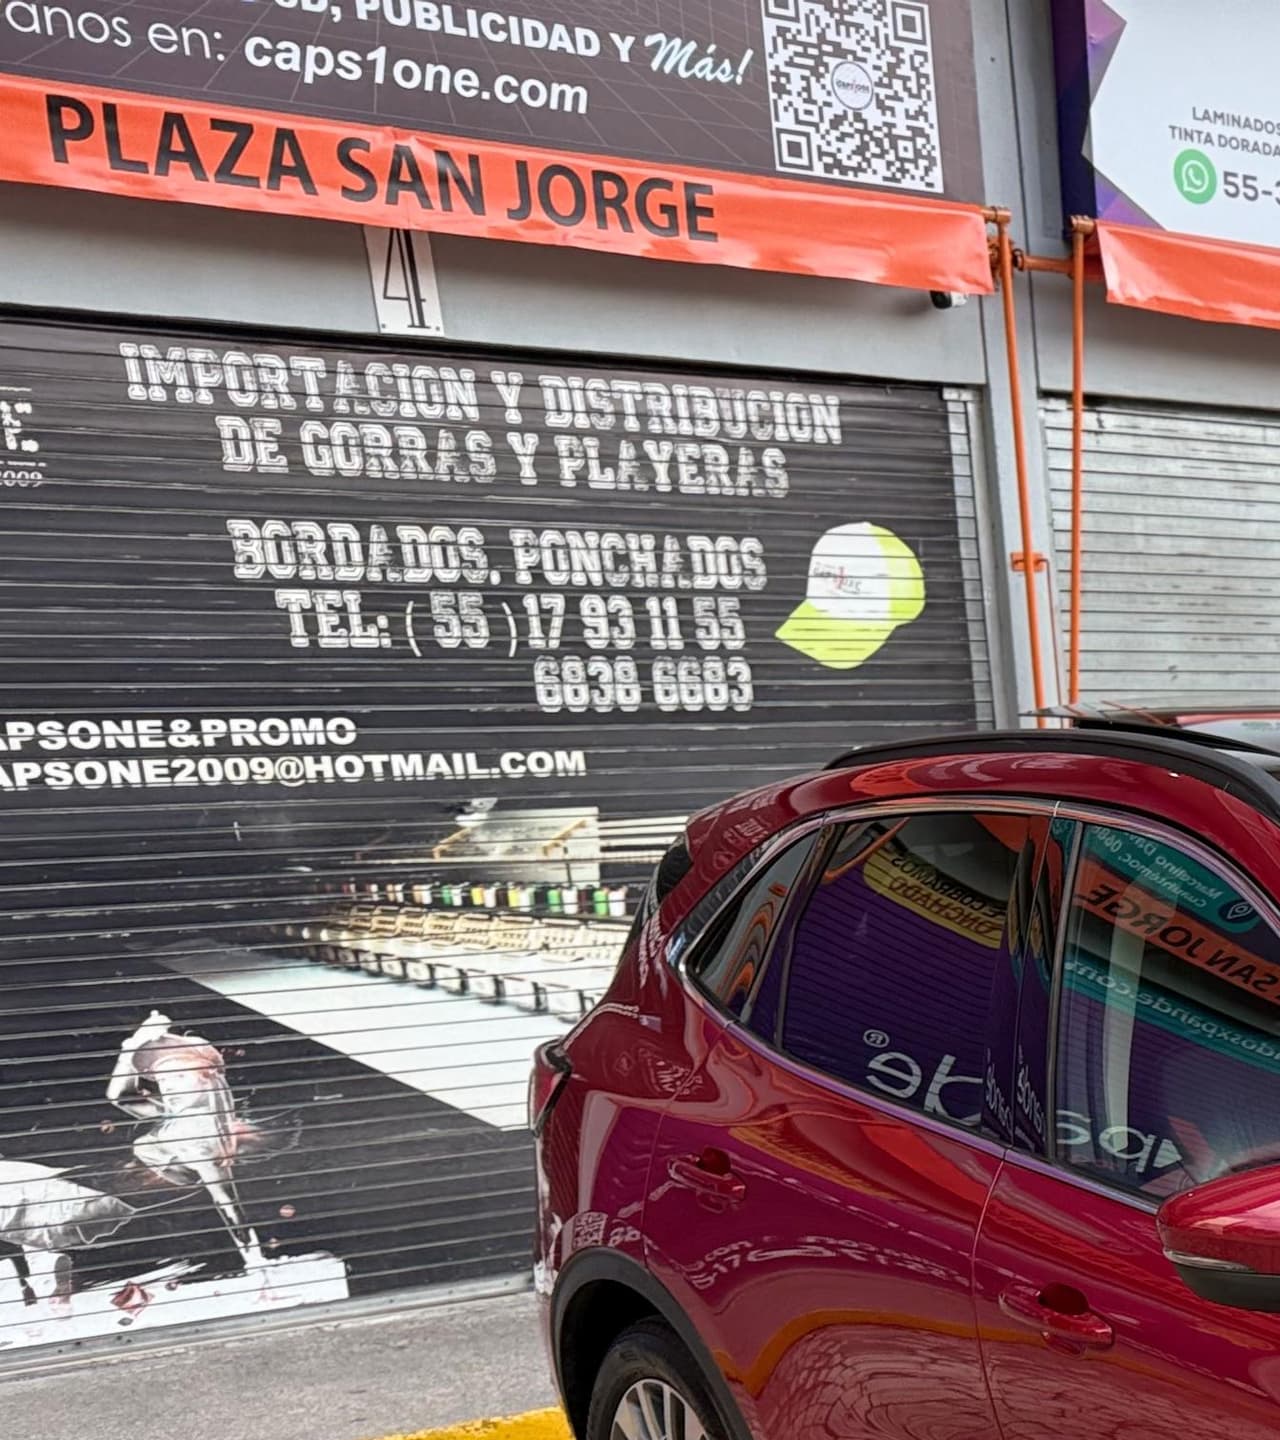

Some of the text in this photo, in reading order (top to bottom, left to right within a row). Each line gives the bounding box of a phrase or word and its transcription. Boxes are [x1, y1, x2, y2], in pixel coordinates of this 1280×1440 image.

[148, 22, 226, 62] en:
[245, 36, 588, 114] caps1one.com
[356, 0, 600, 58] PUBLICIDAD
[610, 34, 636, 62] Y
[645, 33, 754, 85] Más!
[45, 94, 719, 242] PLAZA SAN JORGE
[1168, 125, 1214, 146] TINTA
[119, 342, 842, 444] IMPORTACION Y DISTRIBUCION
[214, 415, 789, 498] DE GORRAS Y PLAYERAS
[509, 529, 768, 590] PONCHADOS
[275, 589, 392, 648] TEL:
[580, 594, 636, 650] 93
[646, 596, 684, 650] 11
[693, 596, 745, 650] 55
[534, 655, 754, 712] 6838 6683
